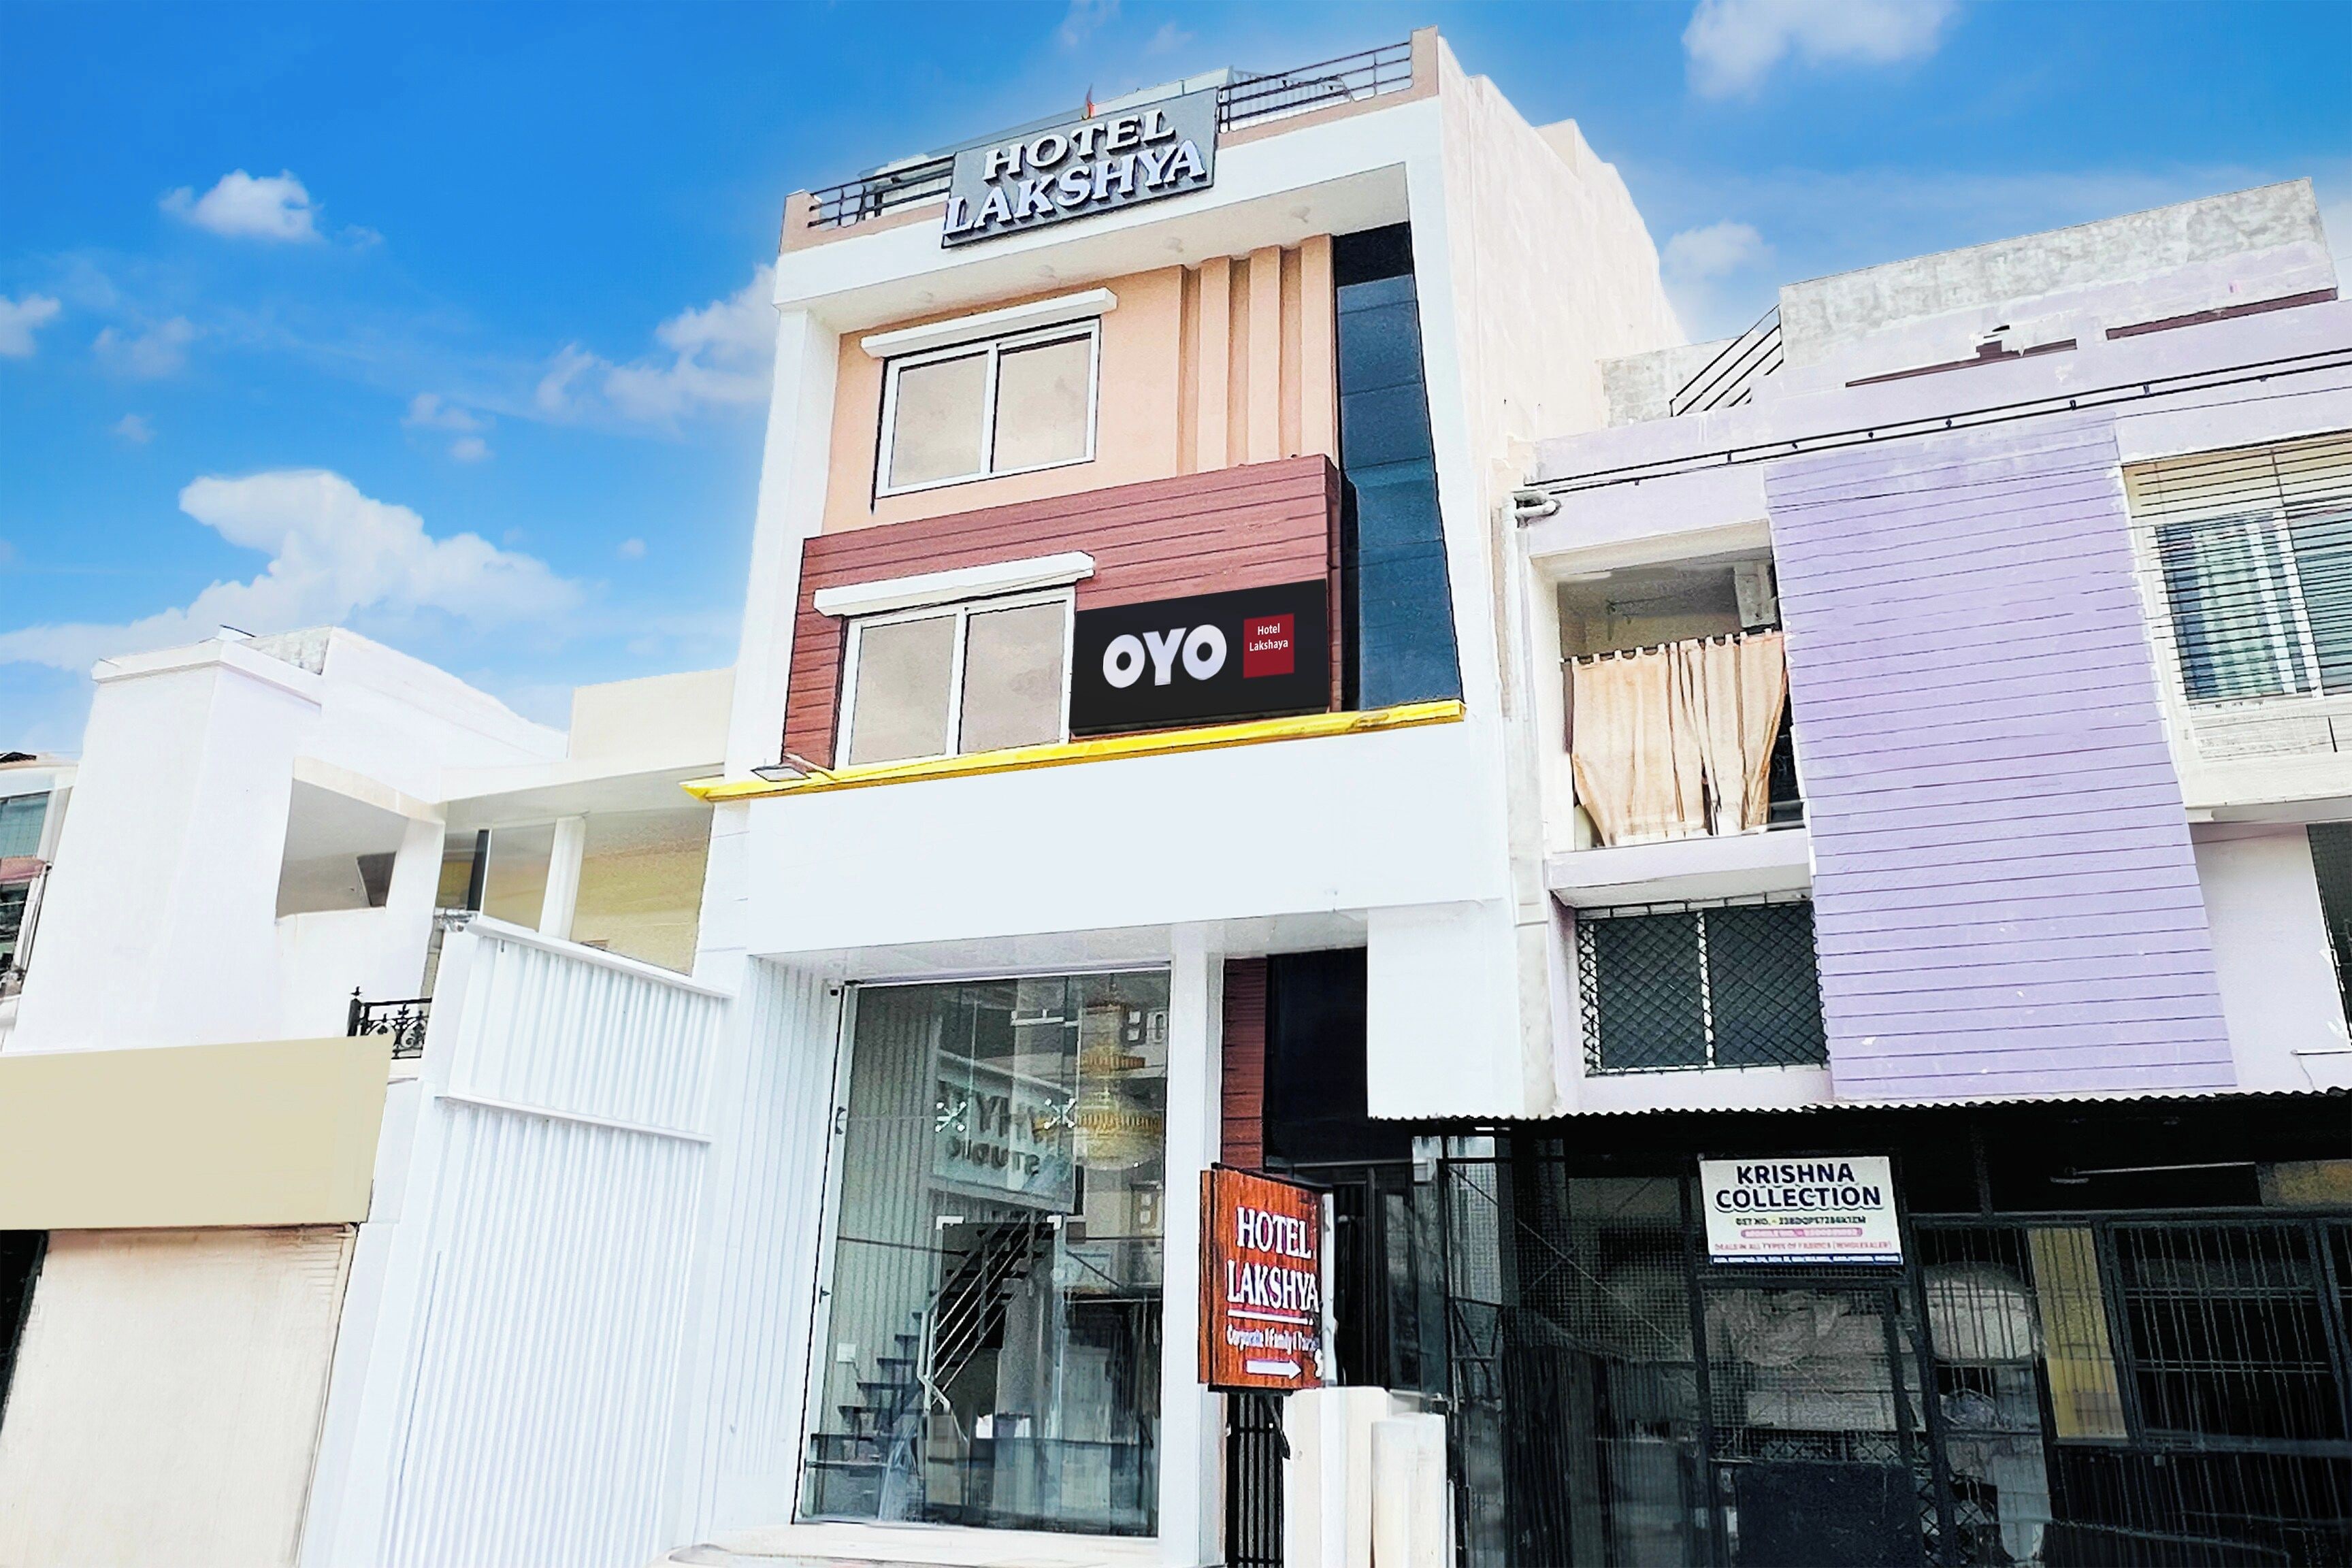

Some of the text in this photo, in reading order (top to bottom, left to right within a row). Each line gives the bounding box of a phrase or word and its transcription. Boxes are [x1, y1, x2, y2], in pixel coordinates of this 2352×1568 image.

[984, 109, 1175, 180] HOTEL
[943, 140, 1206, 235] LAKSHYA
[1103, 624, 1227, 688] OYO
[1250, 638, 1288, 652] Lakshaya
[1257, 623, 1280, 636] Hotel
[1716, 1186, 1881, 1208] COLLECTION
[1737, 1163, 1855, 1185] KRISHNA
[1237, 1206, 1311, 1259] HOTEL
[1227, 1259, 1320, 1313] LAKSHYA
